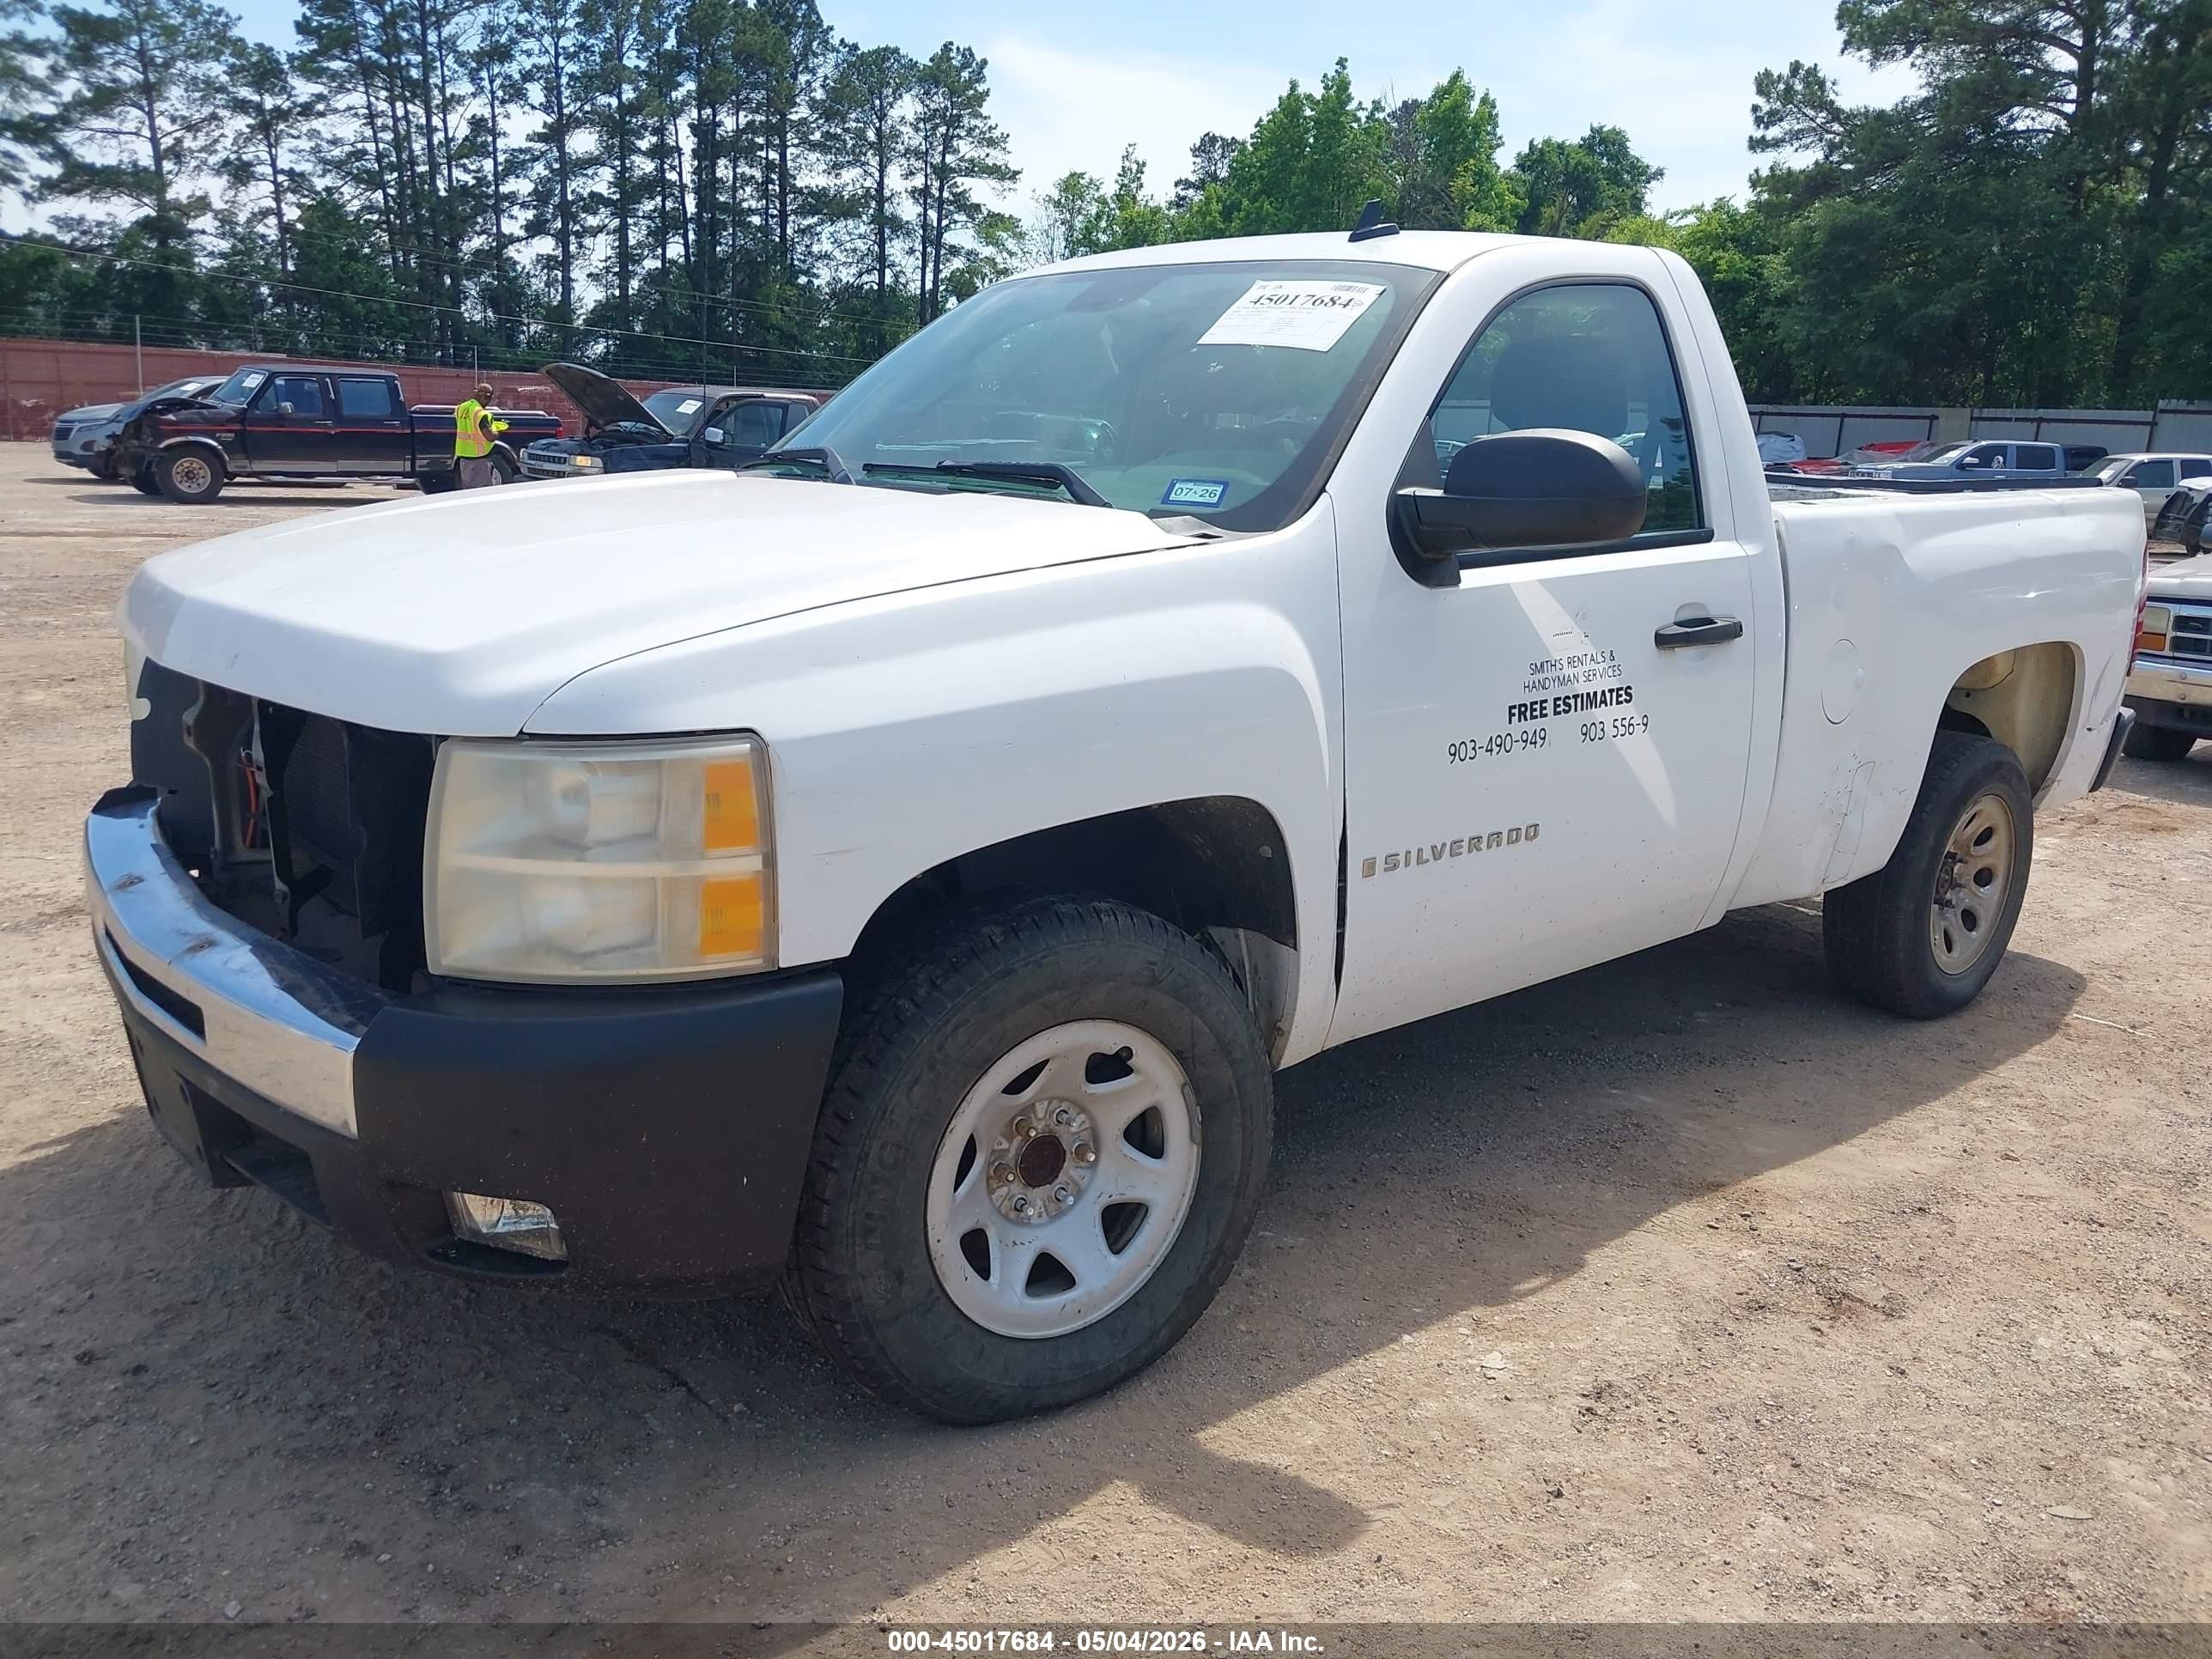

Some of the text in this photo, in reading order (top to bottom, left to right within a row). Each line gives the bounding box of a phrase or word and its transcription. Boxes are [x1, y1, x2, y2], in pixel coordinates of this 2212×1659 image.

[1250, 294, 1355, 309] 45017684
[1529, 649, 1615, 676] SMITH'S RENTALS &
[1523, 664, 1622, 694] HANDYMAN SERVICES
[1508, 685, 1633, 725] FREE ESTIMATES
[1580, 714, 1650, 744] 903 556-9
[1448, 727, 1547, 764] 903-490-949
[1383, 823, 1540, 872] SILVERADO
